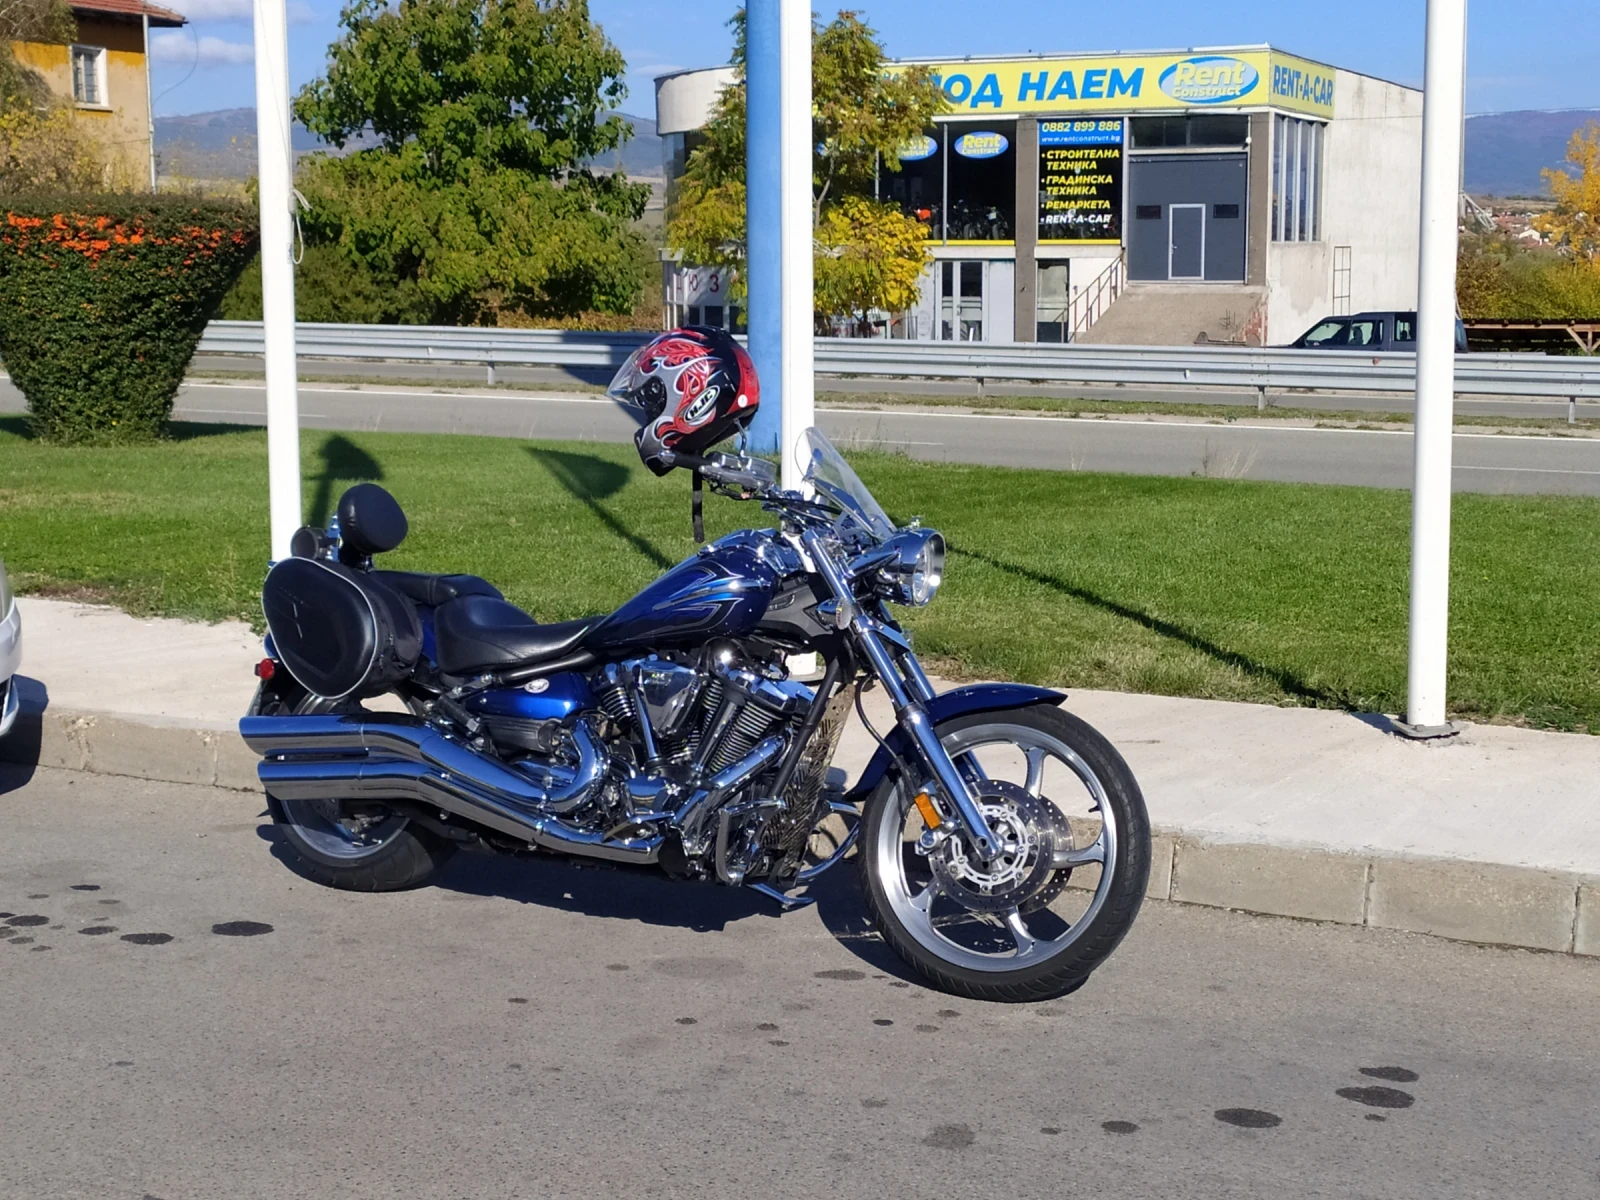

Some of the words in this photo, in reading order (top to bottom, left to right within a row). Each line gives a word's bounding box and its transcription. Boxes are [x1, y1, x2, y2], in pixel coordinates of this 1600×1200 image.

[1174, 61, 1246, 86] Rent
[1017, 67, 1145, 102] НАЕМ
[1273, 65, 1334, 106] RENT-A-CAR
[1171, 85, 1241, 98] Construct
[1041, 122, 1071, 132] 0882
[1073, 121, 1096, 131] 899
[1098, 121, 1121, 131] 886
[962, 134, 1001, 148] Rent
[1046, 149, 1120, 159] СТРОИТЕЛНА
[1046, 161, 1097, 170] ТЕХНИКА
[1046, 175, 1113, 185] ГРАДИНСКА
[1046, 186, 1097, 195] ТЕХНИКА
[1046, 200, 1111, 209] РЕМАРКЕТА
[1045, 214, 1112, 223] RENT-A-CAR
